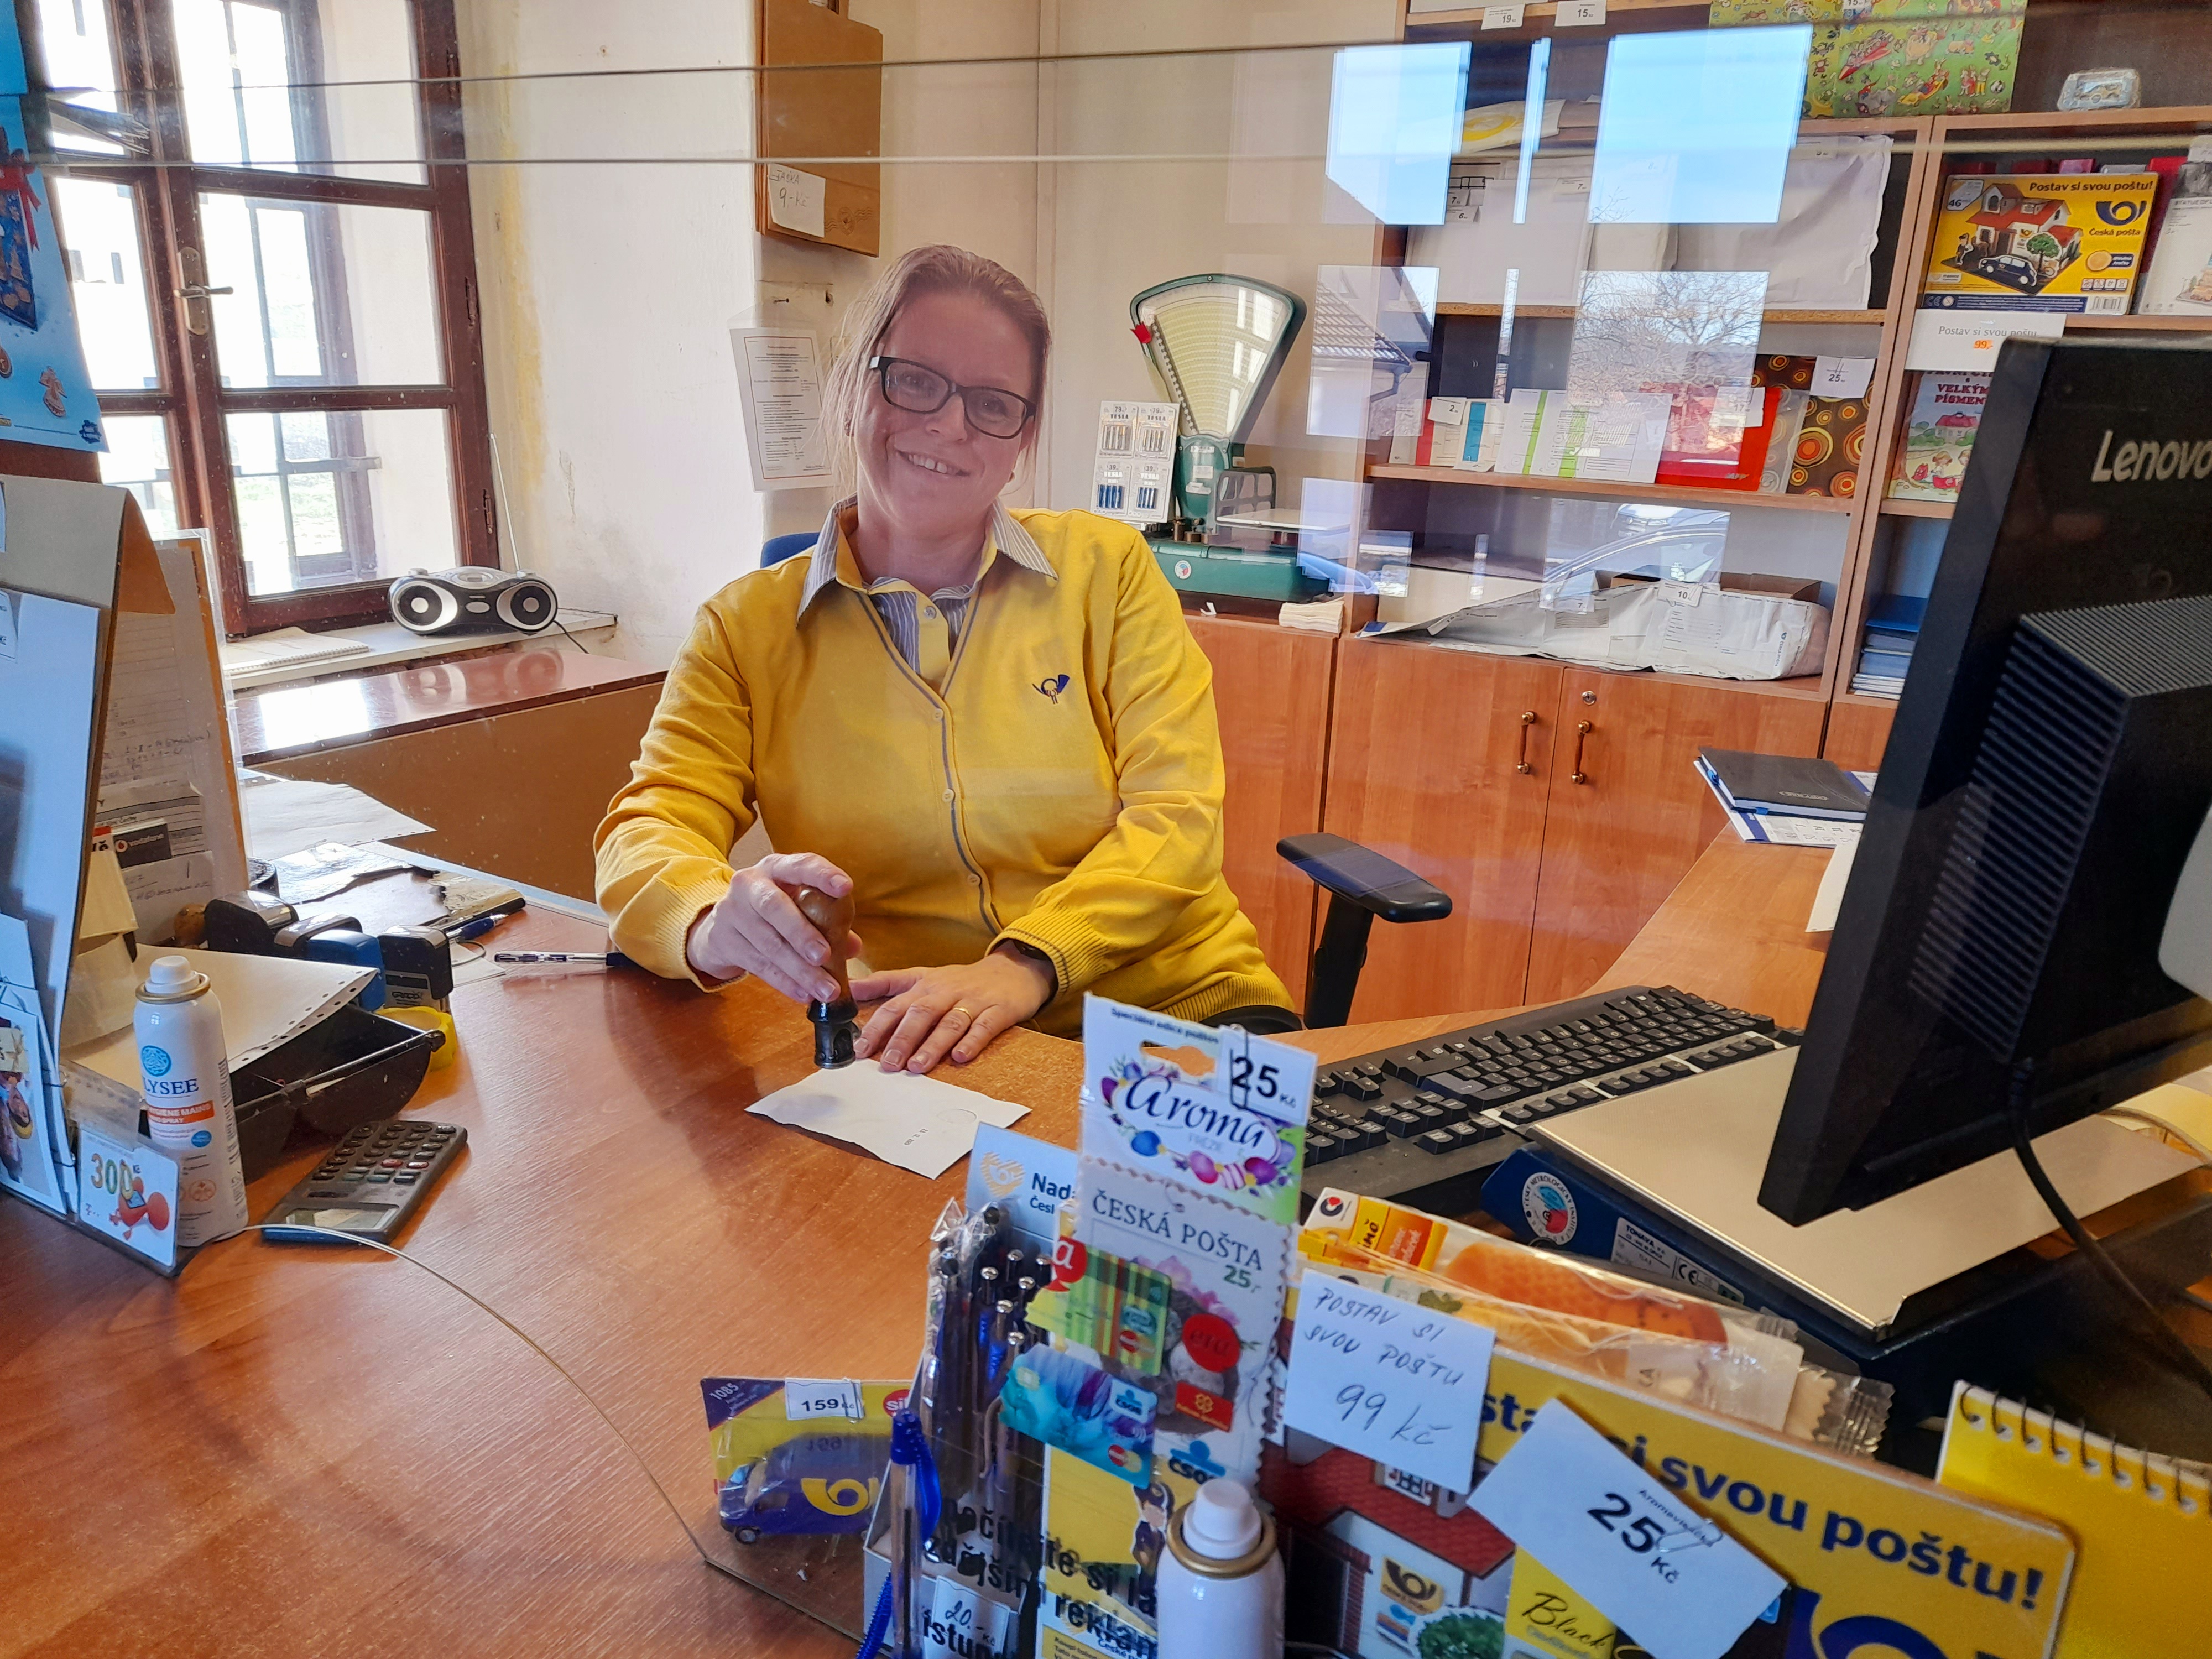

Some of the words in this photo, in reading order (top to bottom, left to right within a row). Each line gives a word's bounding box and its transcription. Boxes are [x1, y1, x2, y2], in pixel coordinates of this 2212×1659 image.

[1502, 14, 1511, 23] 19
[1577, 8, 1588, 18] 15
[2029, 182, 2067, 192] Postav
[2070, 181, 2081, 191] si
[2083, 183, 2111, 191] svou
[2114, 181, 2153, 192] poštu!
[1949, 199, 1962, 208] 46
[2089, 227, 2114, 237] Česká
[2116, 228, 2141, 237] pošta
[1938, 326, 1970, 335] Postav
[1973, 327, 1981, 336] si
[1984, 328, 2007, 337] svou
[1974, 339, 1994, 350] 99,-
[1828, 374, 1840, 382] 25
[2091, 429, 2212, 482] Lenovo
[1677, 590, 1688, 599] 10
[1232, 1056, 1280, 1098] 25
[91, 1152, 134, 1200] 300
[1092, 1188, 1172, 1238] ČESKÁ
[1181, 1223, 1262, 1271] POŠTA
[1314, 1287, 1400, 1325] POSTAV
[1412, 1322, 1447, 1342] SI
[1304, 1325, 1361, 1354] SVOU
[1377, 1343, 1464, 1386] POŠTU
[801, 1398, 839, 1412] 159
[1335, 1384, 1387, 1432] 99
[1587, 1493, 1666, 1554] 25
[1651, 1556, 1681, 1584] Kč
[1661, 1455, 1808, 1532] svou
[1821, 1508, 2045, 1610] poštu!
[1522, 1592, 1614, 1648] Black
